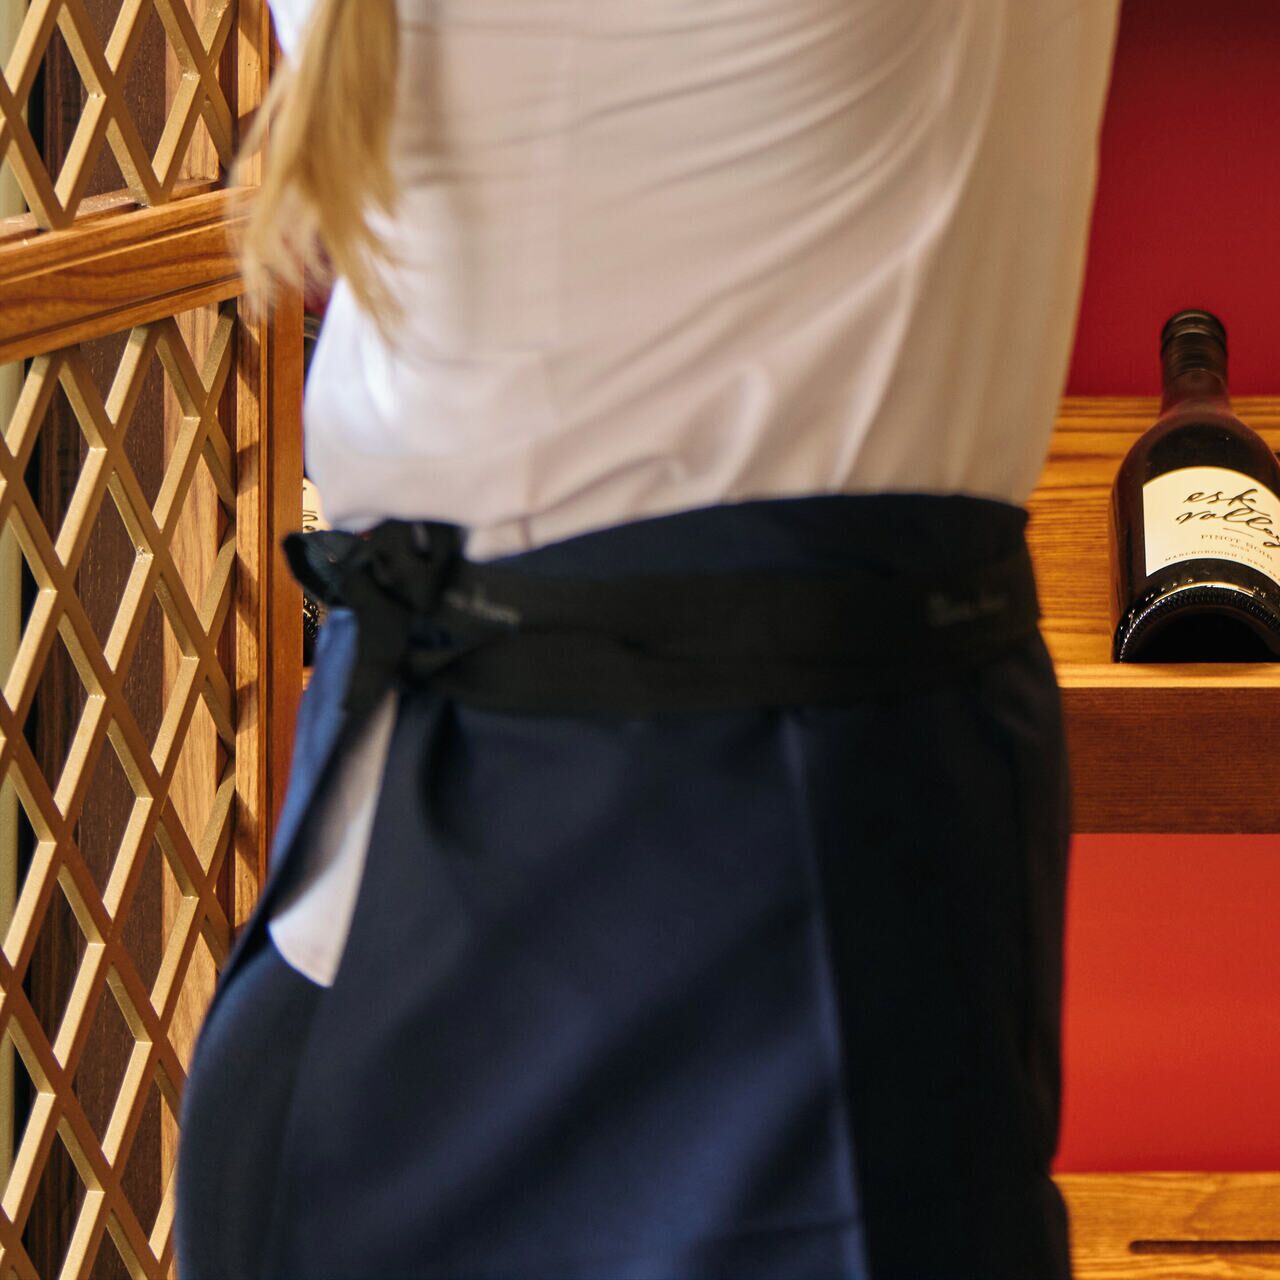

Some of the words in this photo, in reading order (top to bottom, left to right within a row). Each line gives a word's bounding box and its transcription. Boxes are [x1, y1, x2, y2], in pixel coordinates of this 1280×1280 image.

[1182, 488, 1272, 517] esk
[1164, 549, 1238, 562] MARLBOROUGH
[1200, 534, 1241, 544] PINOT
[1245, 541, 1274, 561] NOIR
